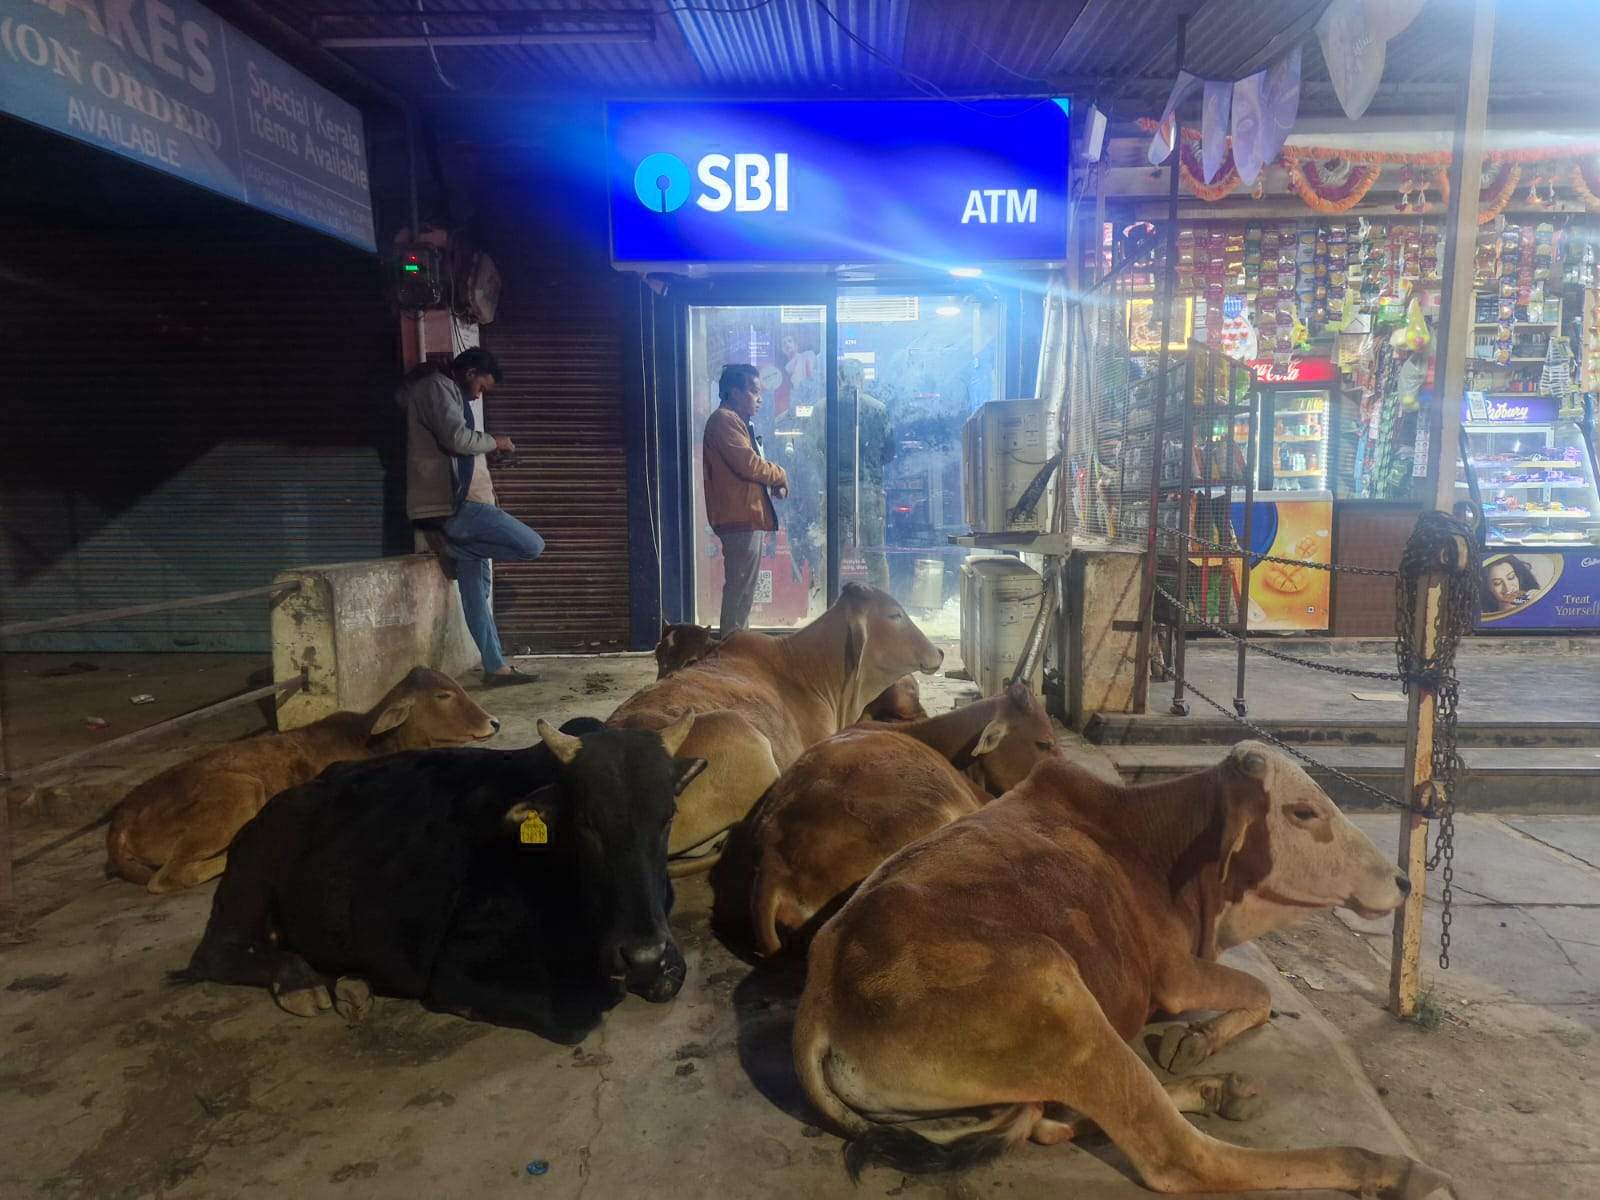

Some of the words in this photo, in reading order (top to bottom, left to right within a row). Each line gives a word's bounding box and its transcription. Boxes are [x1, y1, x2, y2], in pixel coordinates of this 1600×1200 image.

[2, 17, 83, 84] (ON
[91, 61, 221, 149] ORDER)
[247, 61, 310, 127] Special
[312, 100, 361, 157] Kerala
[68, 96, 181, 168] AVAILABLE
[247, 96, 299, 156] Items
[304, 130, 368, 191] Available
[696, 153, 788, 212] SBI
[961, 189, 1038, 224] ATM
[1563, 595, 1591, 604] Treat
